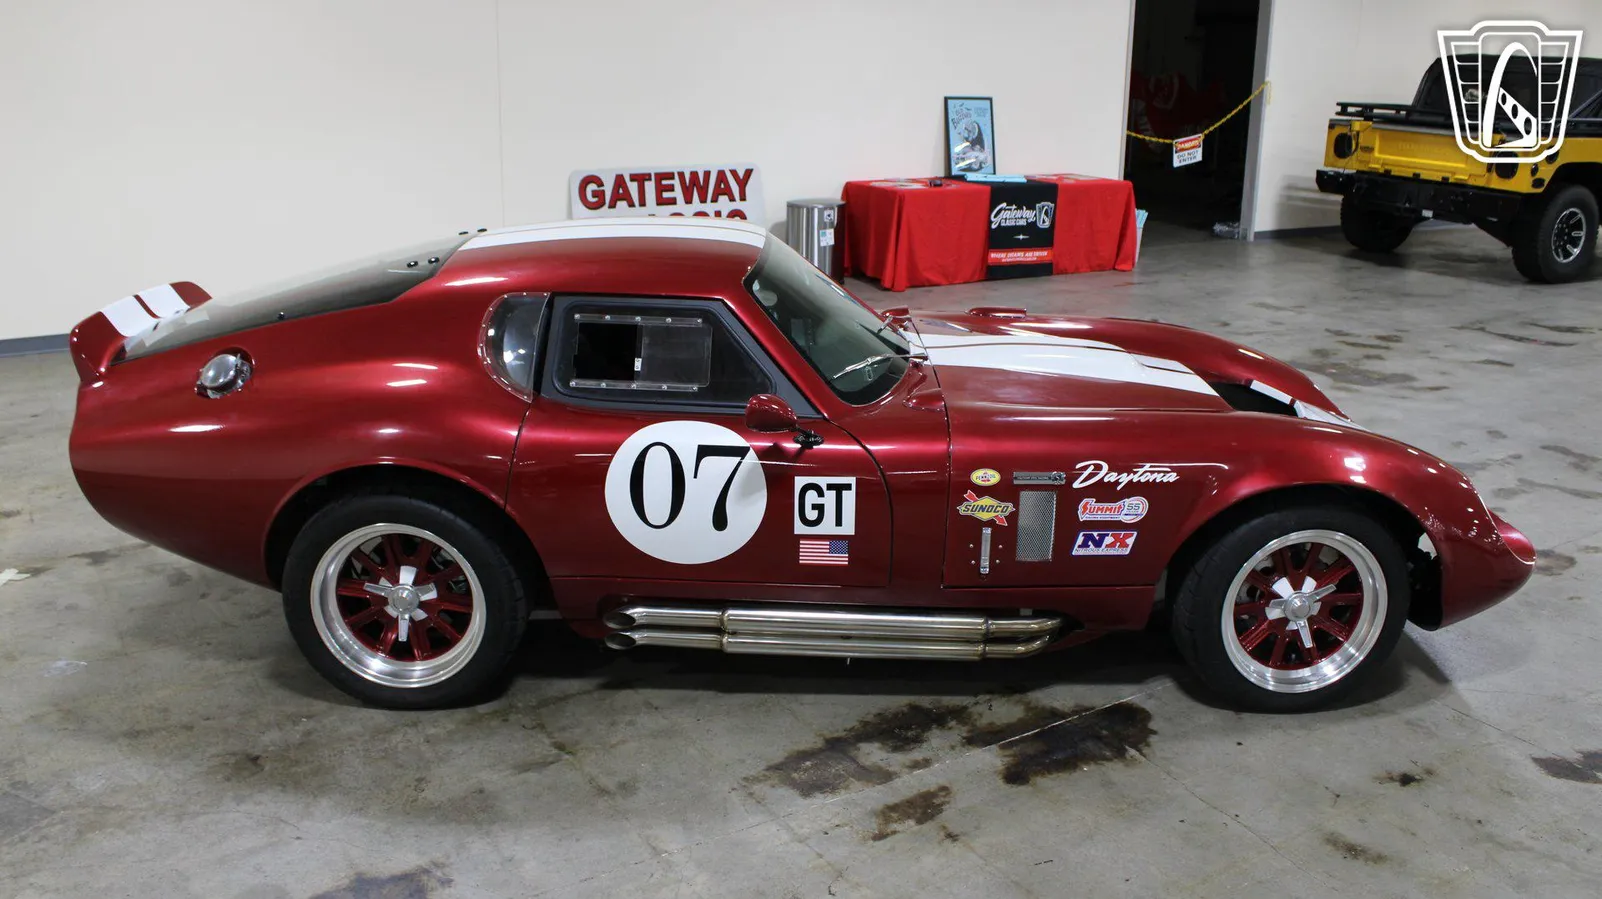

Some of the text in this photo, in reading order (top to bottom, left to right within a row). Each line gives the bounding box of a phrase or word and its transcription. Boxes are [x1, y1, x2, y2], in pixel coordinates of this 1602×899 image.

[578, 168, 754, 211] GATEWAY
[990, 202, 1036, 229] Gateway
[629, 441, 751, 532] 07
[1072, 460, 1180, 491] Daytona
[798, 482, 853, 528] GT
[963, 504, 1010, 514] SUNOCO
[1126, 503, 1141, 511] 55
[1077, 532, 1135, 549] NX
